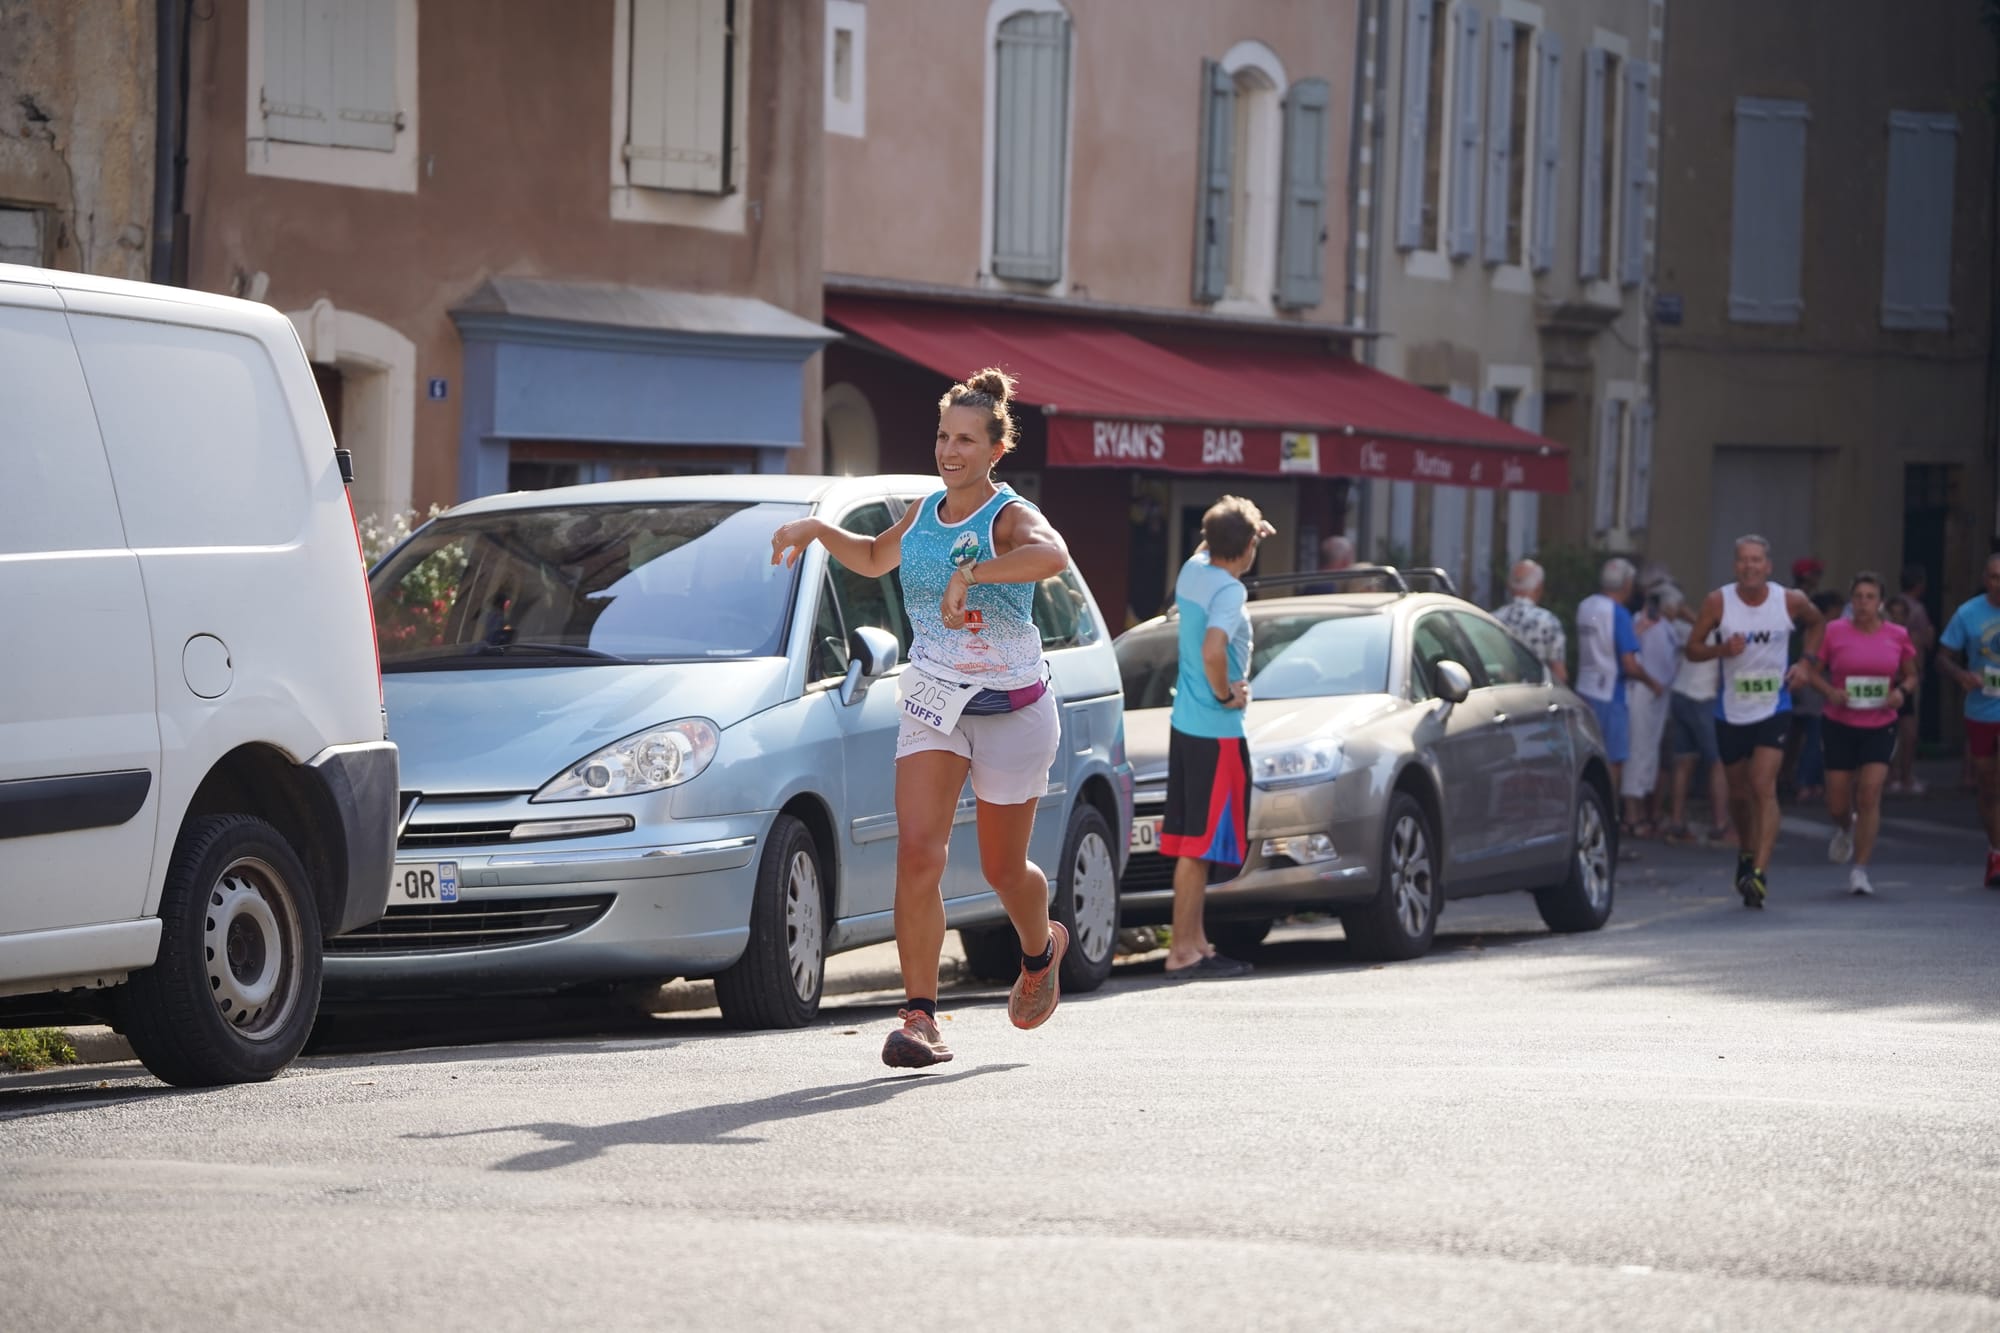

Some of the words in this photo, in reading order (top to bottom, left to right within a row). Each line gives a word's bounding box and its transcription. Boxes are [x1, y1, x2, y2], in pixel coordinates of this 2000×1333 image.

[1092, 420, 1165, 461] RYAN'S
[1202, 427, 1245, 466] BAR
[909, 681, 952, 711] 205
[1741, 679, 1773, 692] 151
[1852, 684, 1884, 698] 155
[903, 699, 943, 727] TUFF'S
[441, 882, 456, 897] 59
